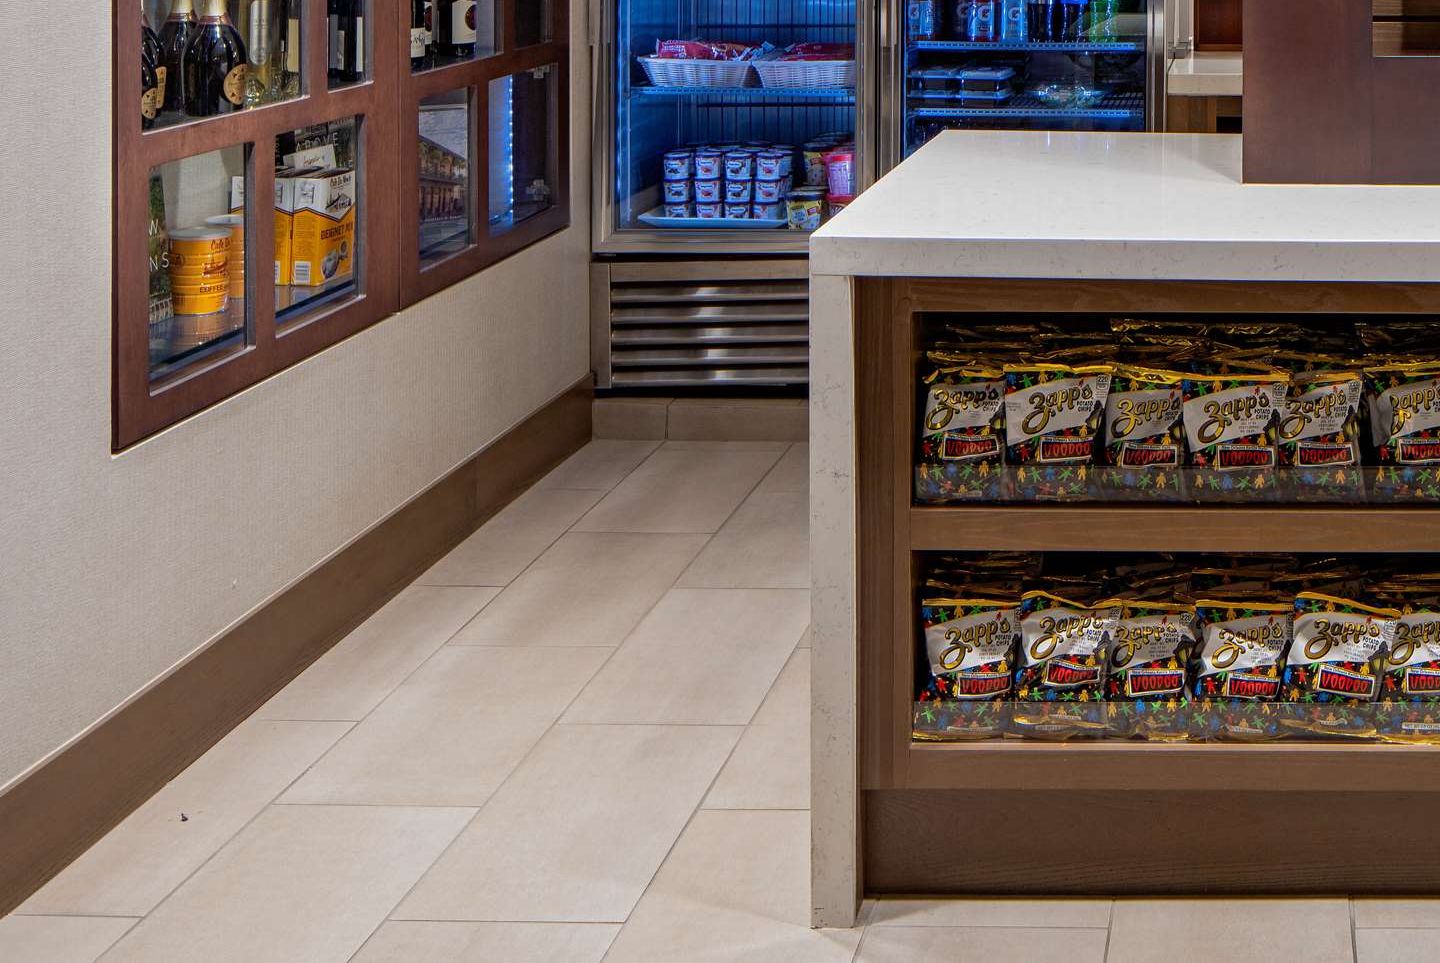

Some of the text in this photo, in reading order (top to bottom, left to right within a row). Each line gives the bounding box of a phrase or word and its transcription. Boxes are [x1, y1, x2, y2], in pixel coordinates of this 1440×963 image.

[321, 226, 344, 239] BEIGNET
[926, 388, 1000, 431] Zapp's
[1022, 386, 1094, 435] Zapp's
[1110, 395, 1182, 439] Zapp's
[1198, 392, 1270, 444] Zapp's
[1254, 407, 1271, 416] POTATO
[1279, 391, 1347, 439] Zapp's
[947, 439, 992, 457] VOODOO
[1044, 441, 1091, 458] VOODOO
[1301, 449, 1348, 463] VOODOO
[1126, 450, 1171, 465] VOODOO
[1221, 450, 1268, 466] VOODOO
[940, 618, 1010, 670] Zapp's
[1030, 615, 1103, 660] Zapp's
[1112, 622, 1177, 667] Zapp's
[1212, 623, 1284, 668] Zapp's
[1304, 619, 1380, 659] Zapp's
[1362, 637, 1380, 646] POTATO
[1050, 668, 1093, 683] VOODOO
[1133, 676, 1178, 691] VOODOO
[1321, 671, 1370, 692] VOODOO
[962, 678, 1008, 694] VOODOO
[1232, 679, 1274, 694] VOODOO
